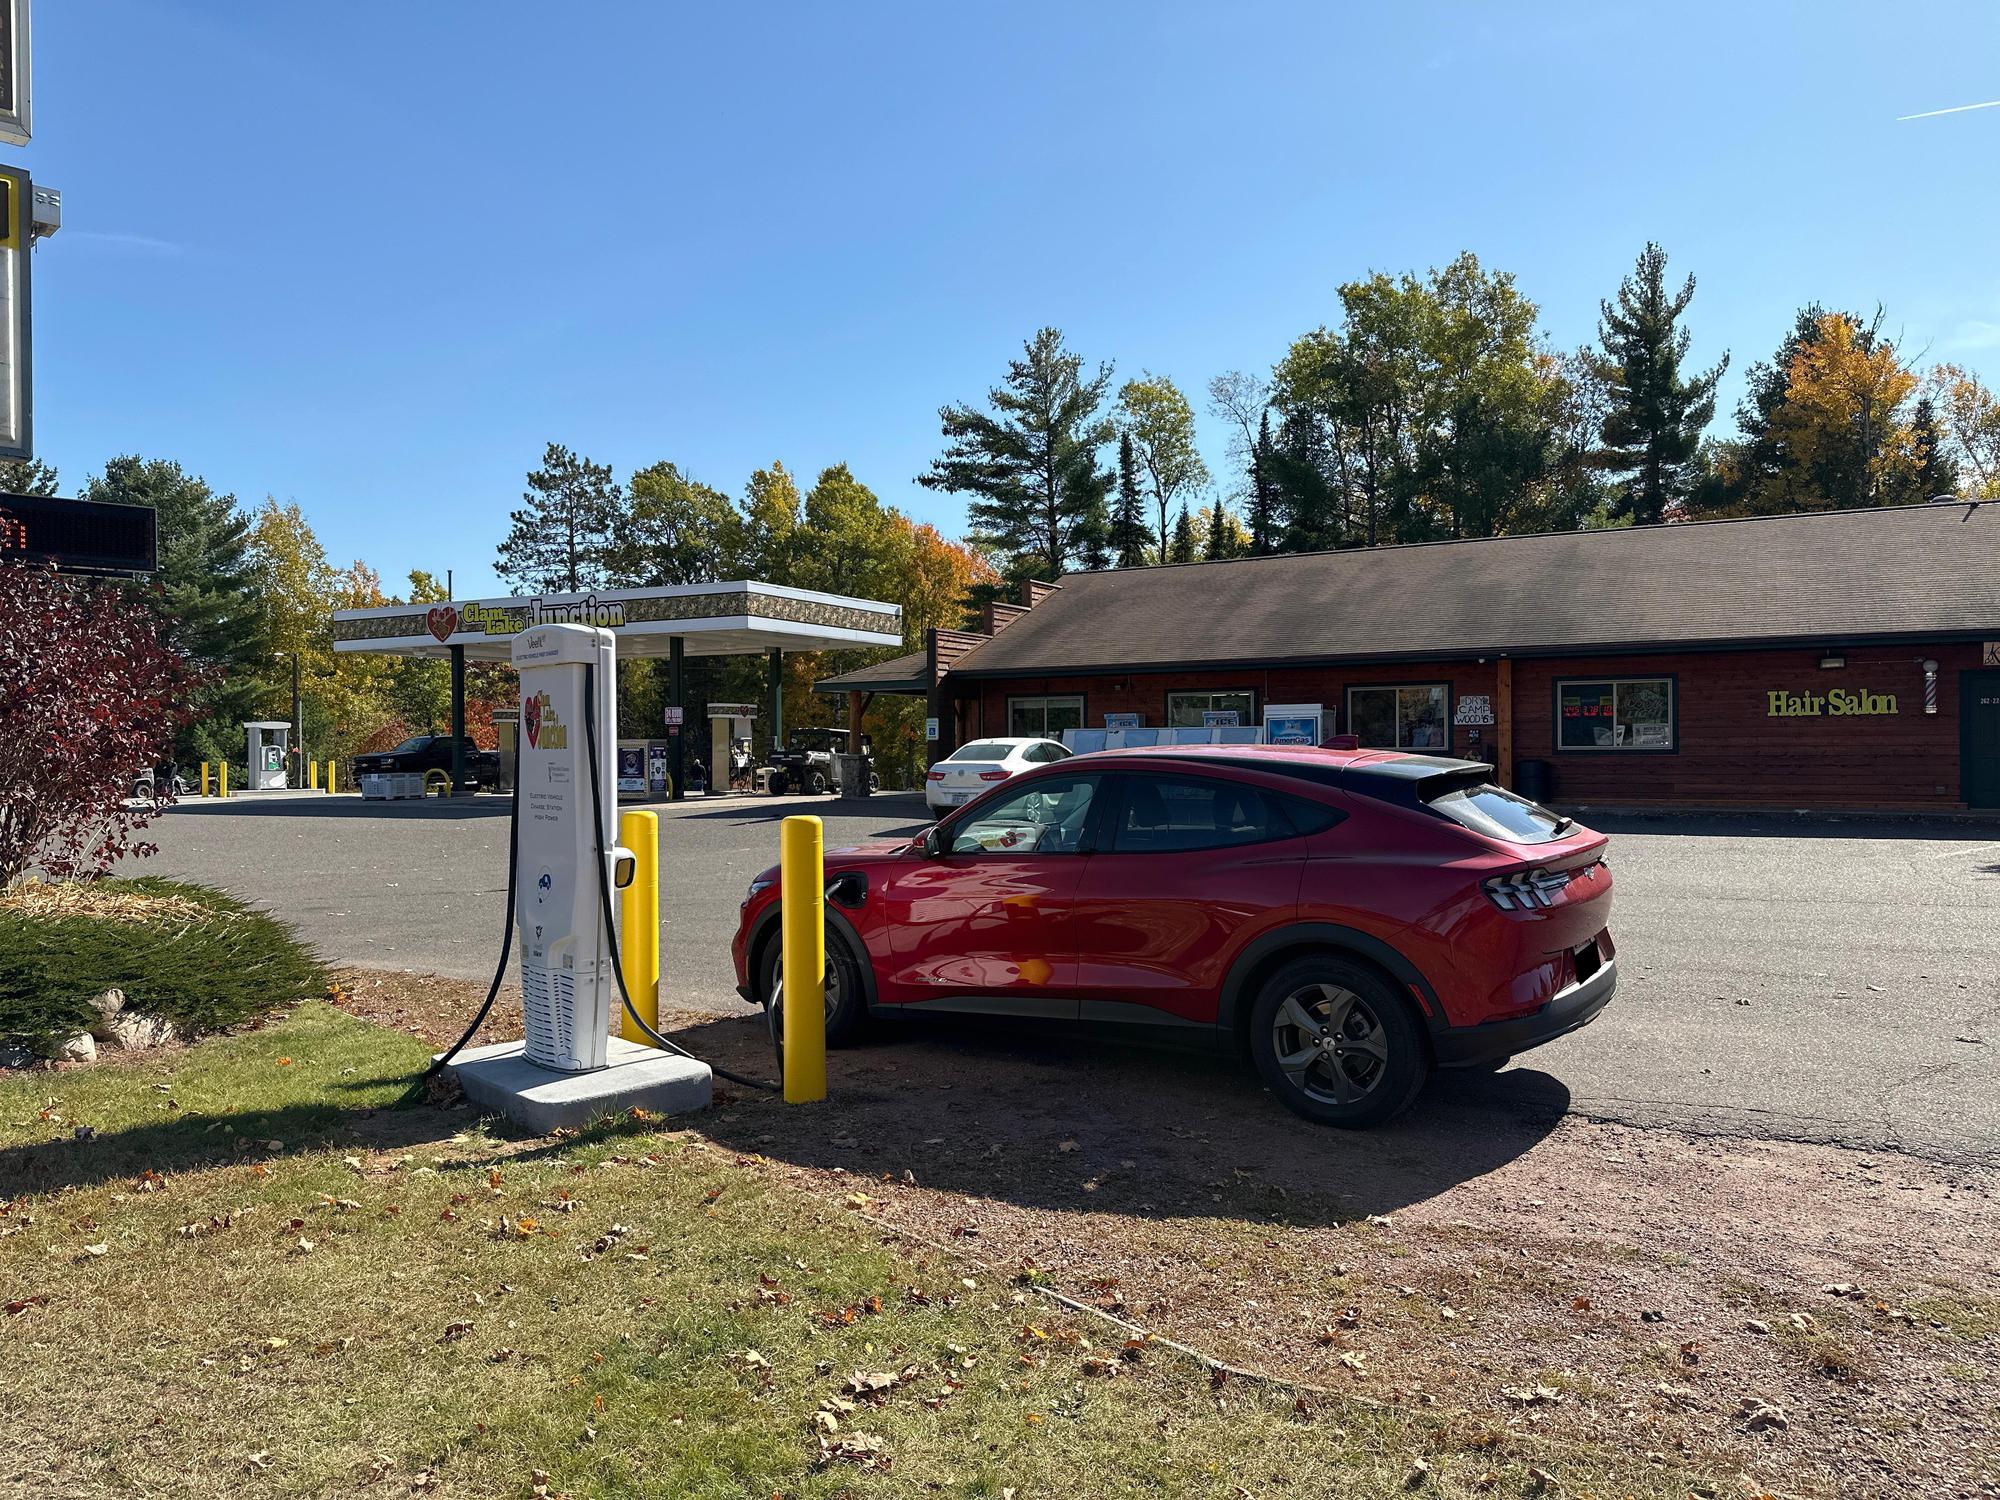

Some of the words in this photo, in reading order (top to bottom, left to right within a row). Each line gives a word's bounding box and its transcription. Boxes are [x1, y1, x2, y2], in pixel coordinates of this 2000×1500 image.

[463, 603, 504, 623] Clam
[528, 595, 626, 628] Junction
[485, 615, 525, 635] Lake
[1465, 696, 1485, 706] DRY
[1767, 690, 1826, 717] Hair
[1828, 688, 1899, 716] Salon
[1458, 705, 1490, 714] CAMP
[1215, 717, 1235, 726] ICE
[1454, 714, 1481, 724] WOOD
[1273, 736, 1311, 745] AmeriGas
